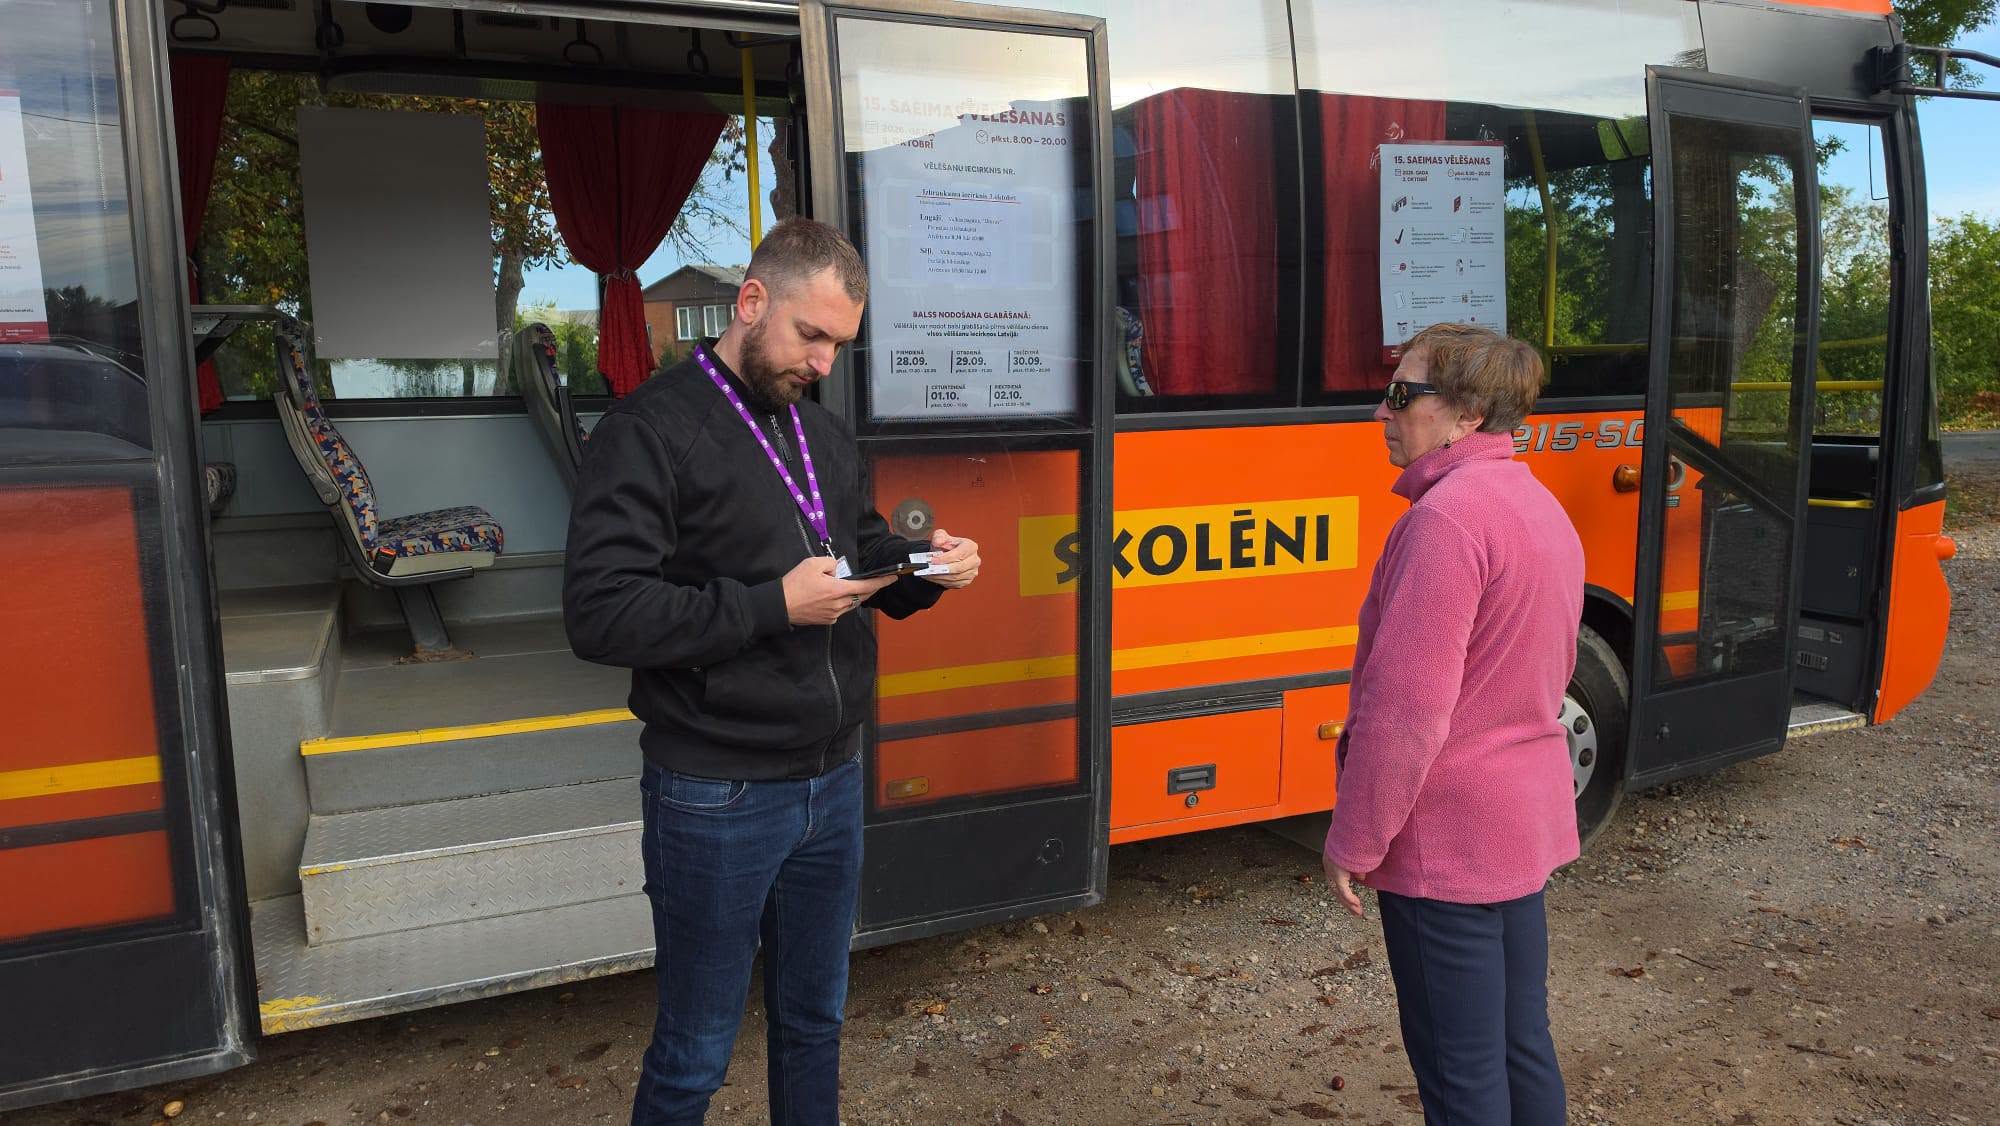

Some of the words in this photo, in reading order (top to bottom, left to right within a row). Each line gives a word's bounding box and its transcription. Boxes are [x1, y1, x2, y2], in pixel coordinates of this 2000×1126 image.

[1394, 156, 1405, 164] 15.
[1407, 156, 1443, 165] SAEIMAS
[1445, 155, 1491, 166] VĒLĒŠANAS
[965, 166, 1001, 174] IECIRKNIS
[938, 310, 982, 318] NODOŠANA
[896, 357, 928, 366] 28.09.
[956, 357, 987, 366] 29.09.
[1013, 357, 1042, 366] 30.09.
[930, 391, 960, 400] 01.10.
[994, 391, 1022, 400] 02.10.
